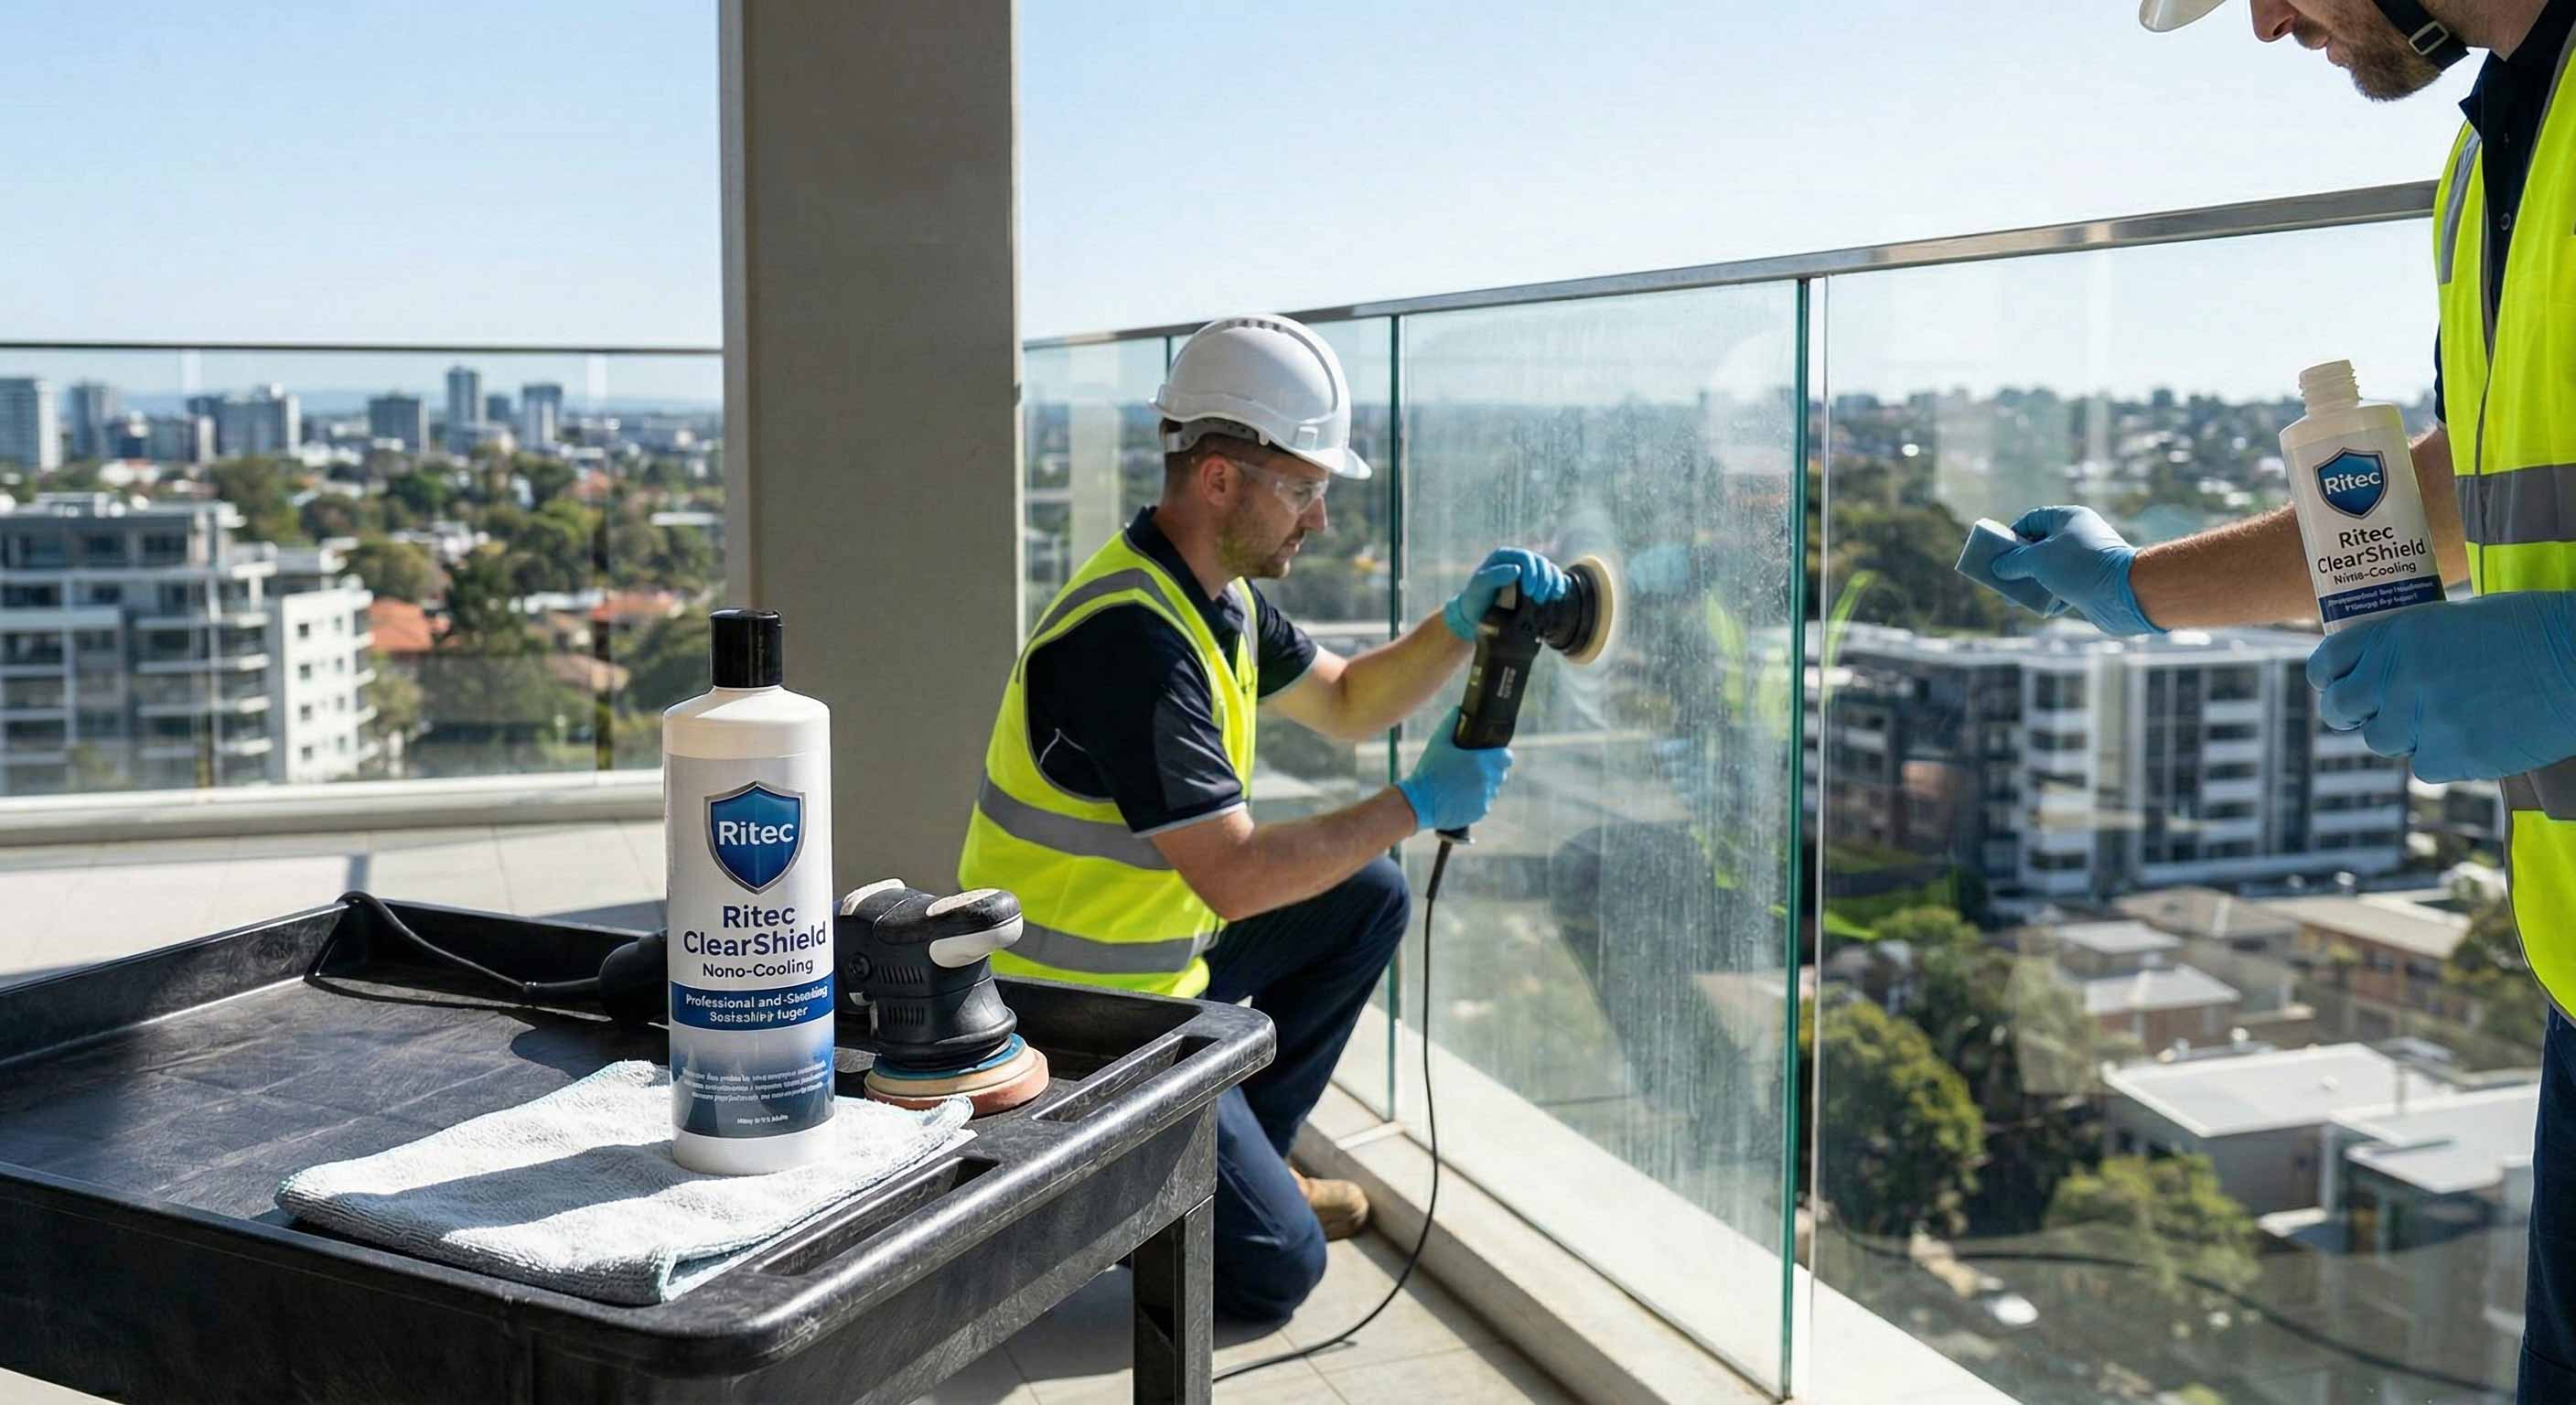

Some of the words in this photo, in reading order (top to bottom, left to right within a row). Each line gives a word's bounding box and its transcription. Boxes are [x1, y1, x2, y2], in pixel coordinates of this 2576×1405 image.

[2324, 472, 2381, 495] Ritec
[2339, 527, 2394, 549] Ritec
[2317, 538, 2427, 574] ClearShield
[718, 820, 794, 845] Ritec
[723, 905, 796, 928] Ritec
[683, 920, 826, 957] ClearShield
[703, 959, 813, 978] Nono-Cooling
[686, 993, 755, 1009] Professional
[758, 994, 782, 1007] and
